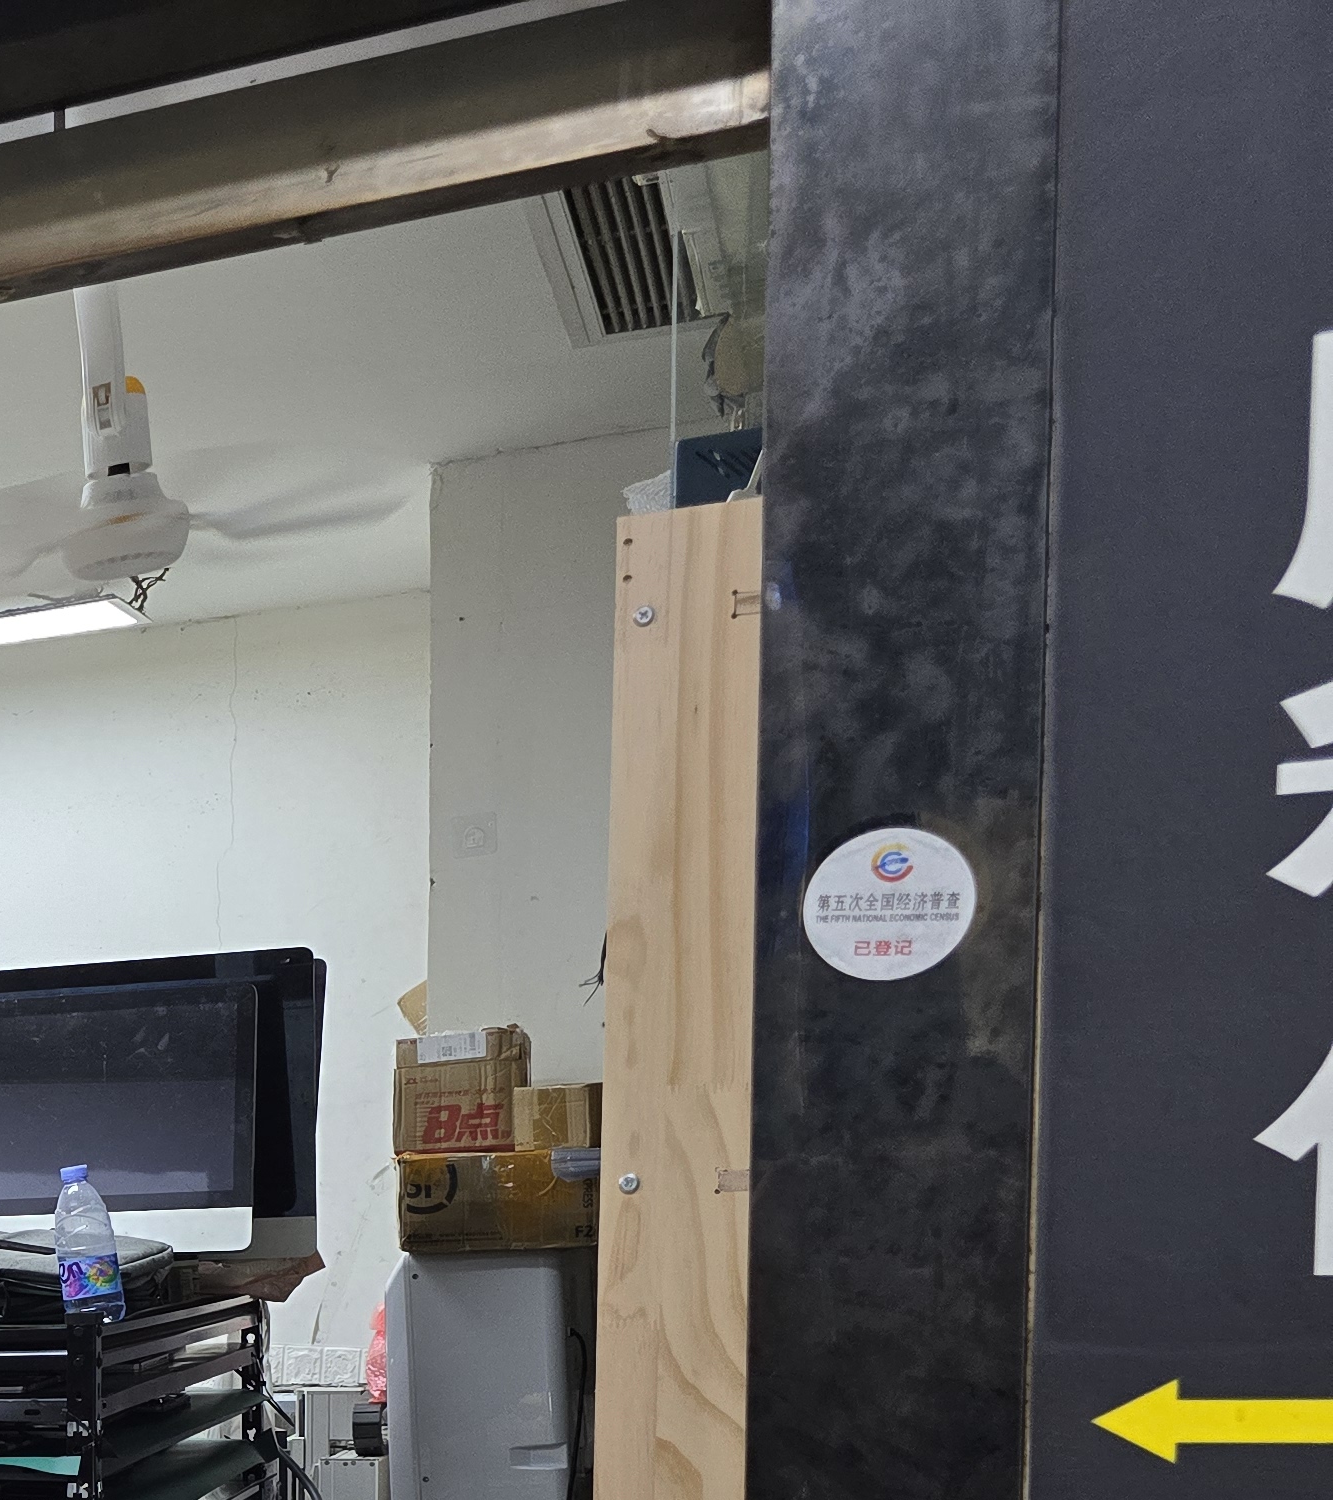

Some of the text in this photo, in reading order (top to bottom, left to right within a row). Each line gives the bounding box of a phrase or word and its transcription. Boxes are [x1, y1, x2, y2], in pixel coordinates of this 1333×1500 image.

[817, 891, 961, 913] 第五次全国经济普查
[816, 912, 959, 923] THE FIFTH NATIONAL ECONOMIC CENSUS
[853, 938, 913, 957] 已登记
[422, 1102, 505, 1144] 8点
[575, 1225, 593, 1238] F2
